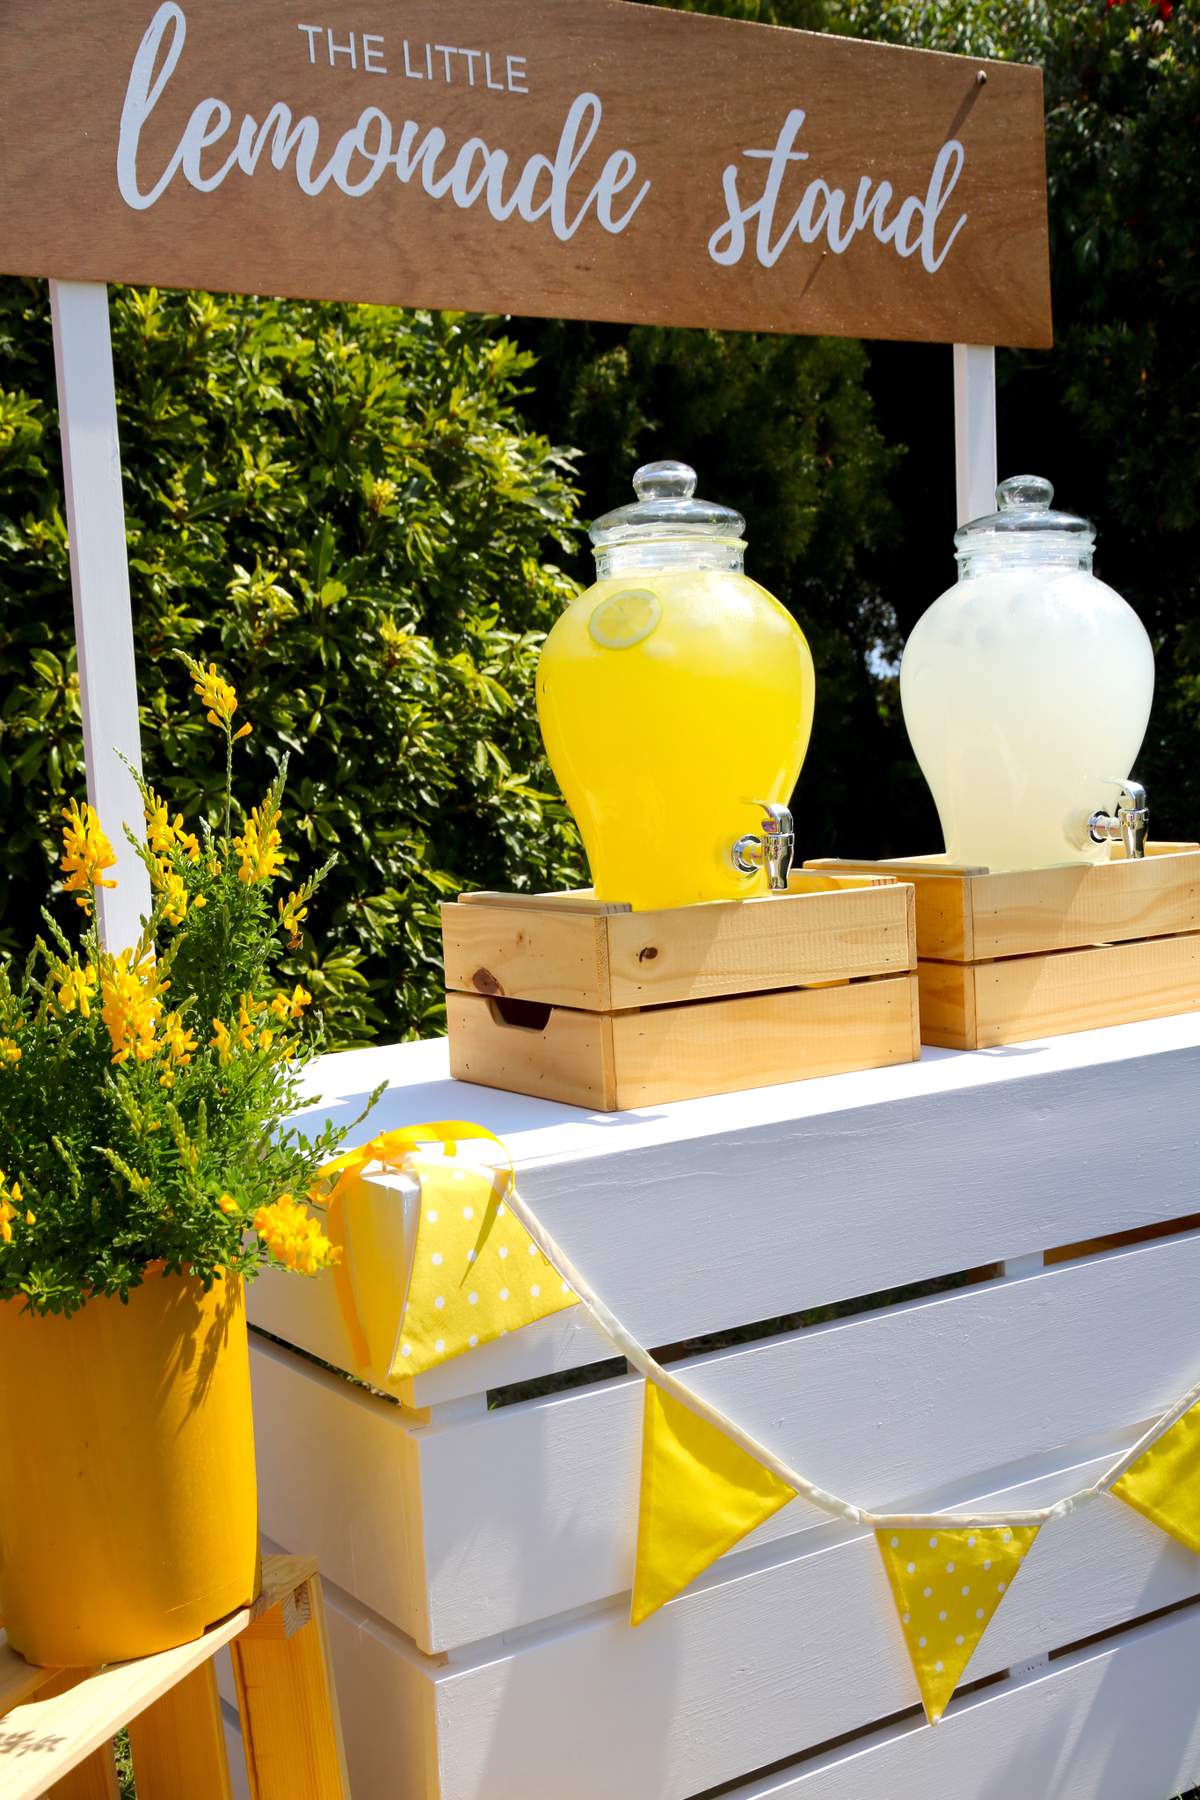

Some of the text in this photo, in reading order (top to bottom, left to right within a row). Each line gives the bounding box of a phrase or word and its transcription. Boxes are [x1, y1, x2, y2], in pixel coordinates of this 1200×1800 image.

[117, 1, 967, 273] lemonade stand
[298, 24, 530, 93] THE LITTLE
